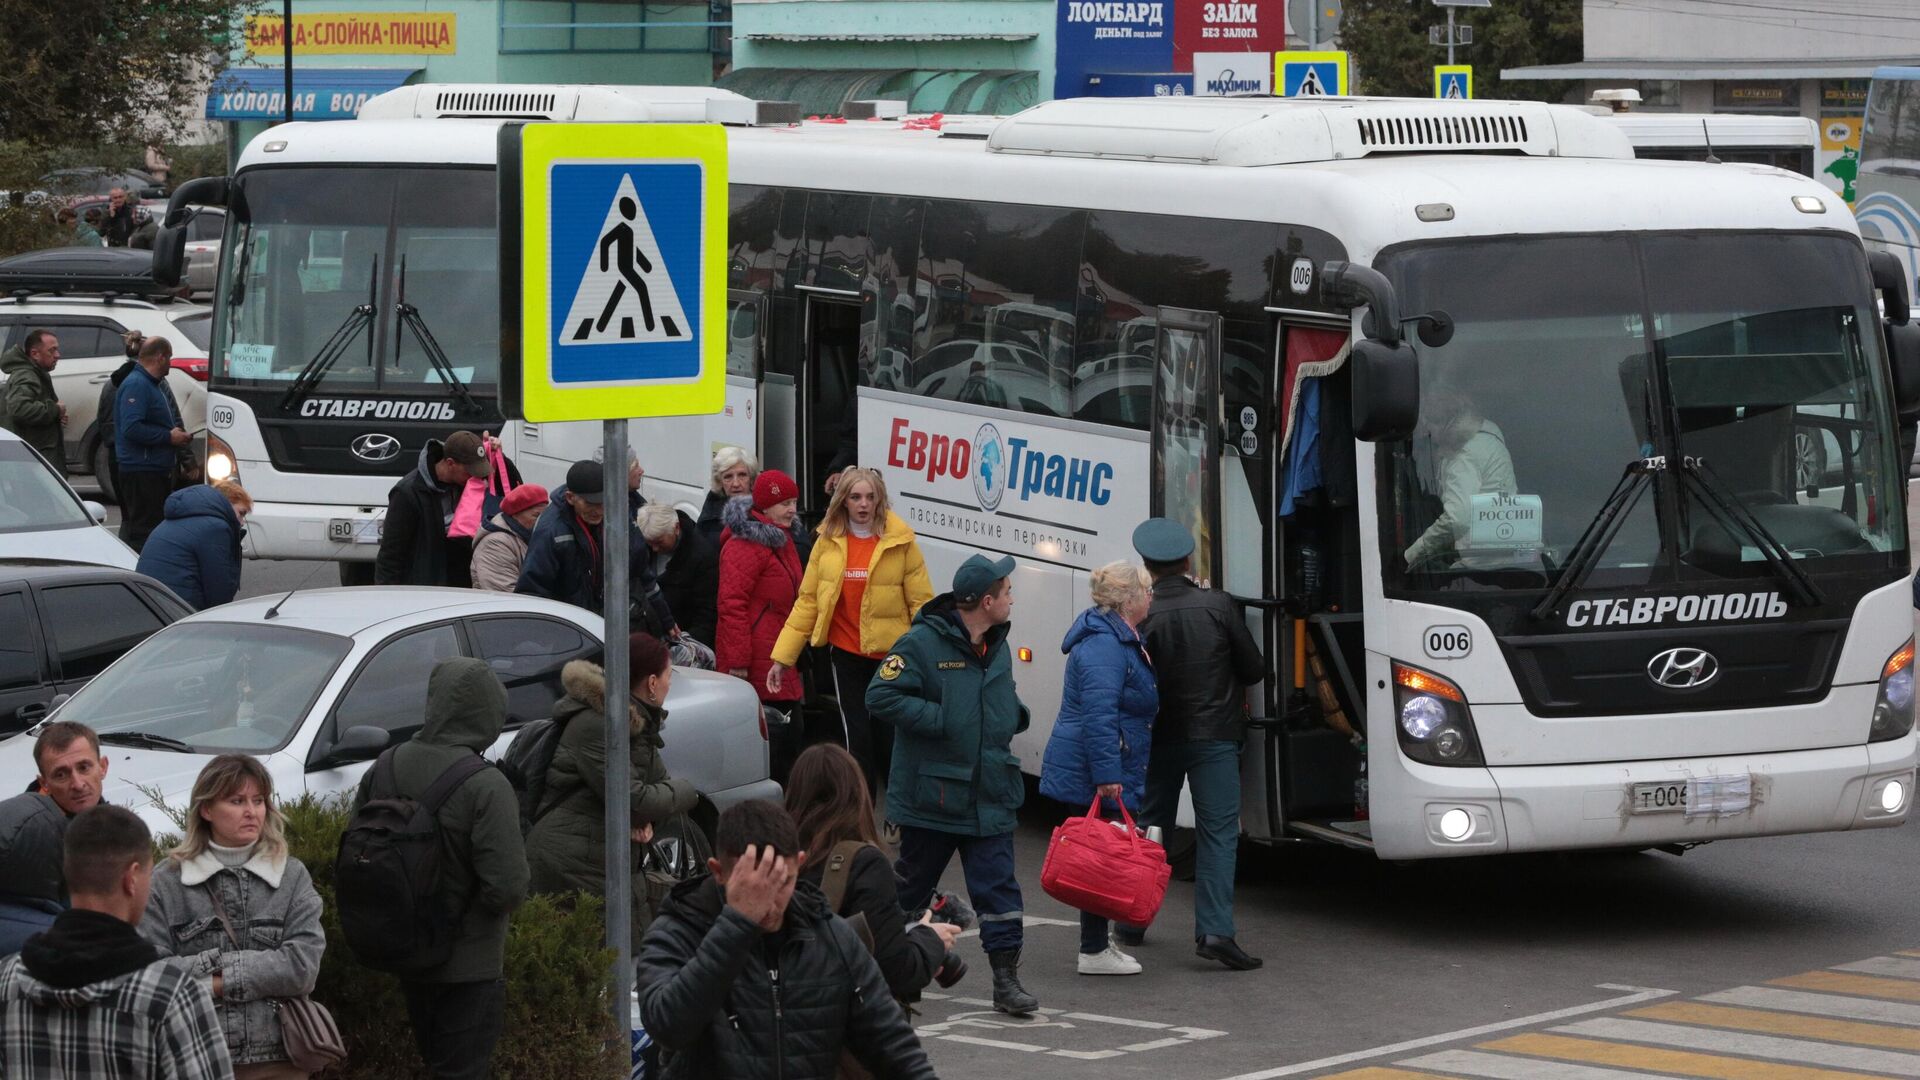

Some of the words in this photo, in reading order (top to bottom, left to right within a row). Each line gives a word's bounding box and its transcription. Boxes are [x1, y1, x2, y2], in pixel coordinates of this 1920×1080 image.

[1067, 2, 1163, 26] ЛОМБАРД
[1203, 0, 1258, 23] ЗАЙМ
[314, 17, 383, 45] СЛОЙКА
[390, 21, 450, 48] ПИЦЦА
[1094, 27, 1132, 39] ДЕНЬГИ
[1202, 27, 1220, 38] БЕЗ
[1223, 27, 1258, 38] ЗАЛОГА
[1207, 77, 1261, 94] MAXIMUM
[330, 92, 376, 115] ВОД
[1293, 267, 1311, 285] 006
[213, 409, 233, 424] 009
[300, 398, 456, 421] СТАВРОПОЛЬ
[887, 417, 971, 483] Евро
[1007, 437, 1114, 506] Транс
[1490, 496, 1522, 508] МЧС
[910, 505, 1003, 539] пассажирские
[1479, 509, 1534, 521] РОССИИ
[1566, 591, 1789, 628] СТАВРОПОЛЬ
[1429, 632, 1470, 652] 006
